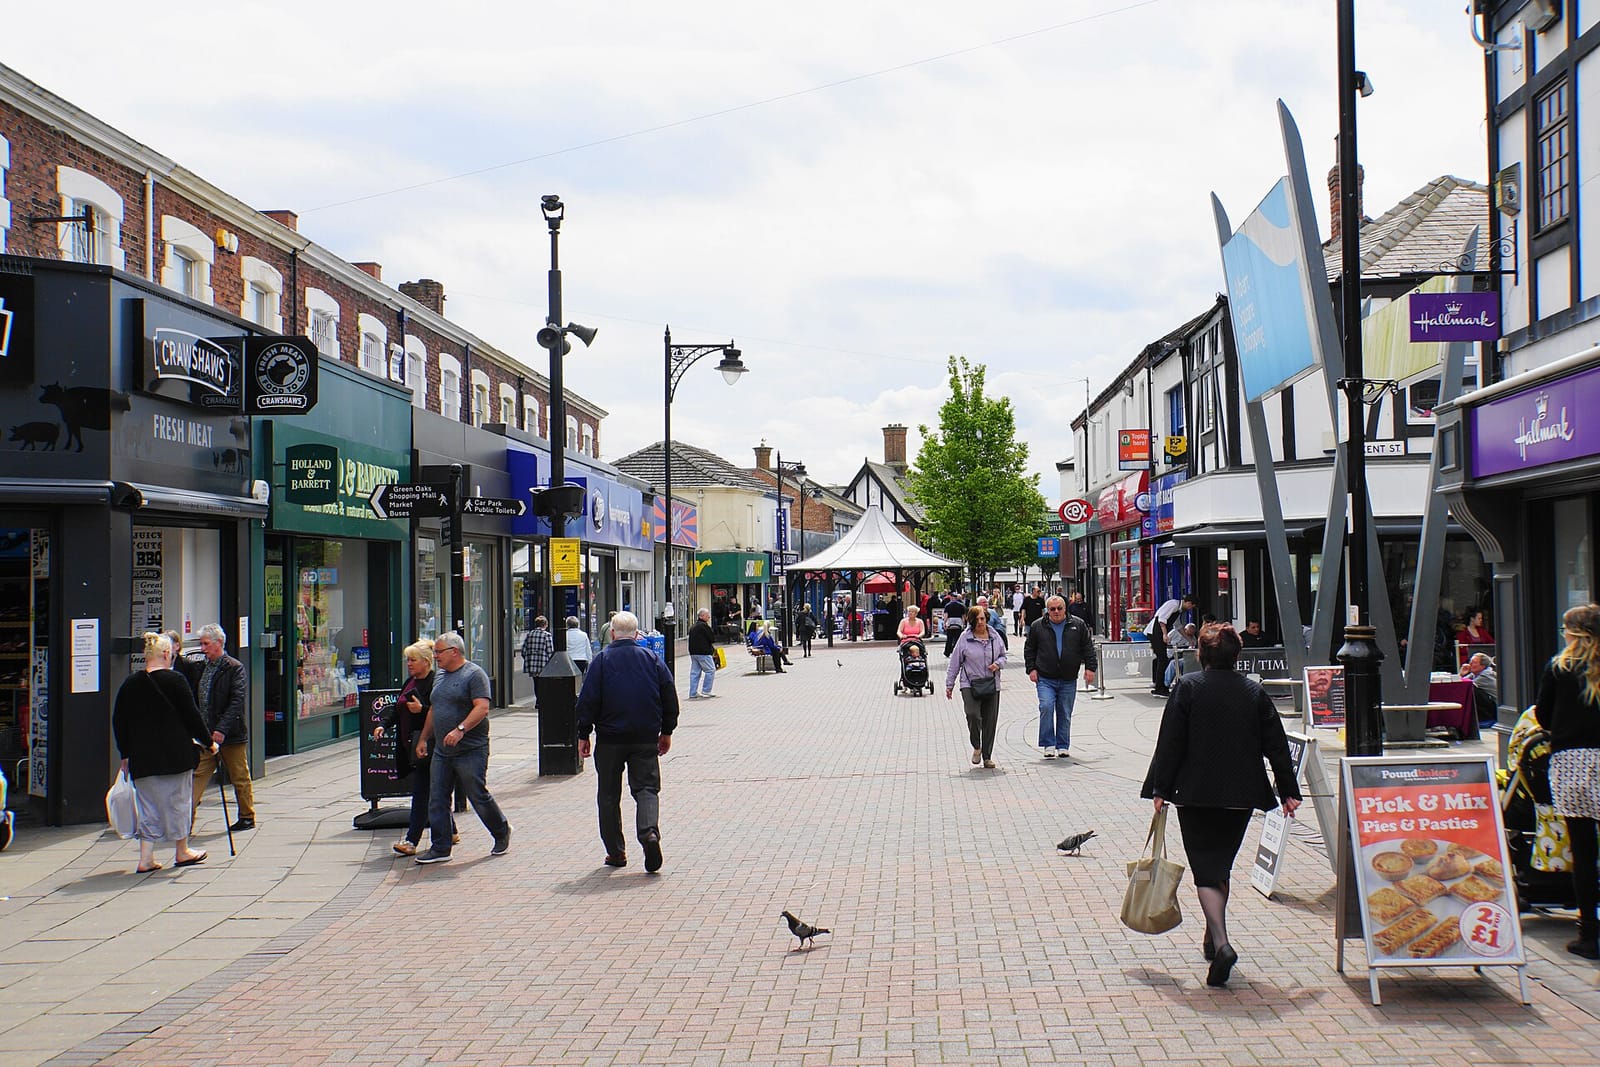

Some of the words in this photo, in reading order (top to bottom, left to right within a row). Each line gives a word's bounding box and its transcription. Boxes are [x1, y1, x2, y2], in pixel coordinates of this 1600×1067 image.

[1413, 310, 1496, 333] Hallmark
[162, 340, 225, 382] CRAWSHAWS
[258, 347, 278, 372] FRESH
[281, 345, 303, 361] MEAT
[262, 379, 285, 393] FOOD
[261, 396, 303, 405] CRAWSHAWS
[153, 414, 185, 443] FRESH
[187, 421, 213, 449] MEAT
[1514, 407, 1574, 461] Hallmark
[1366, 444, 1386, 454] ENT
[291, 460, 332, 470] HOLLAND
[307, 469, 316, 479] &
[291, 479, 331, 490] BARRETT
[393, 485, 414, 493] Green
[388, 492, 420, 501] Shopping
[421, 491, 437, 499] Mall
[494, 507, 516, 515] Toilets
[1236, 660, 1250, 671] EE
[1257, 659, 1289, 671] TIM
[1381, 768, 1458, 780] Poundbakery
[1359, 796, 1415, 814] Pick
[1418, 794, 1438, 811] &
[1442, 793, 1488, 810] Mix
[1362, 820, 1397, 833] Pies
[1400, 818, 1415, 832] &
[1418, 817, 1479, 830] Pasties
[1477, 907, 1493, 925] 2
[1471, 924, 1501, 948] £1
